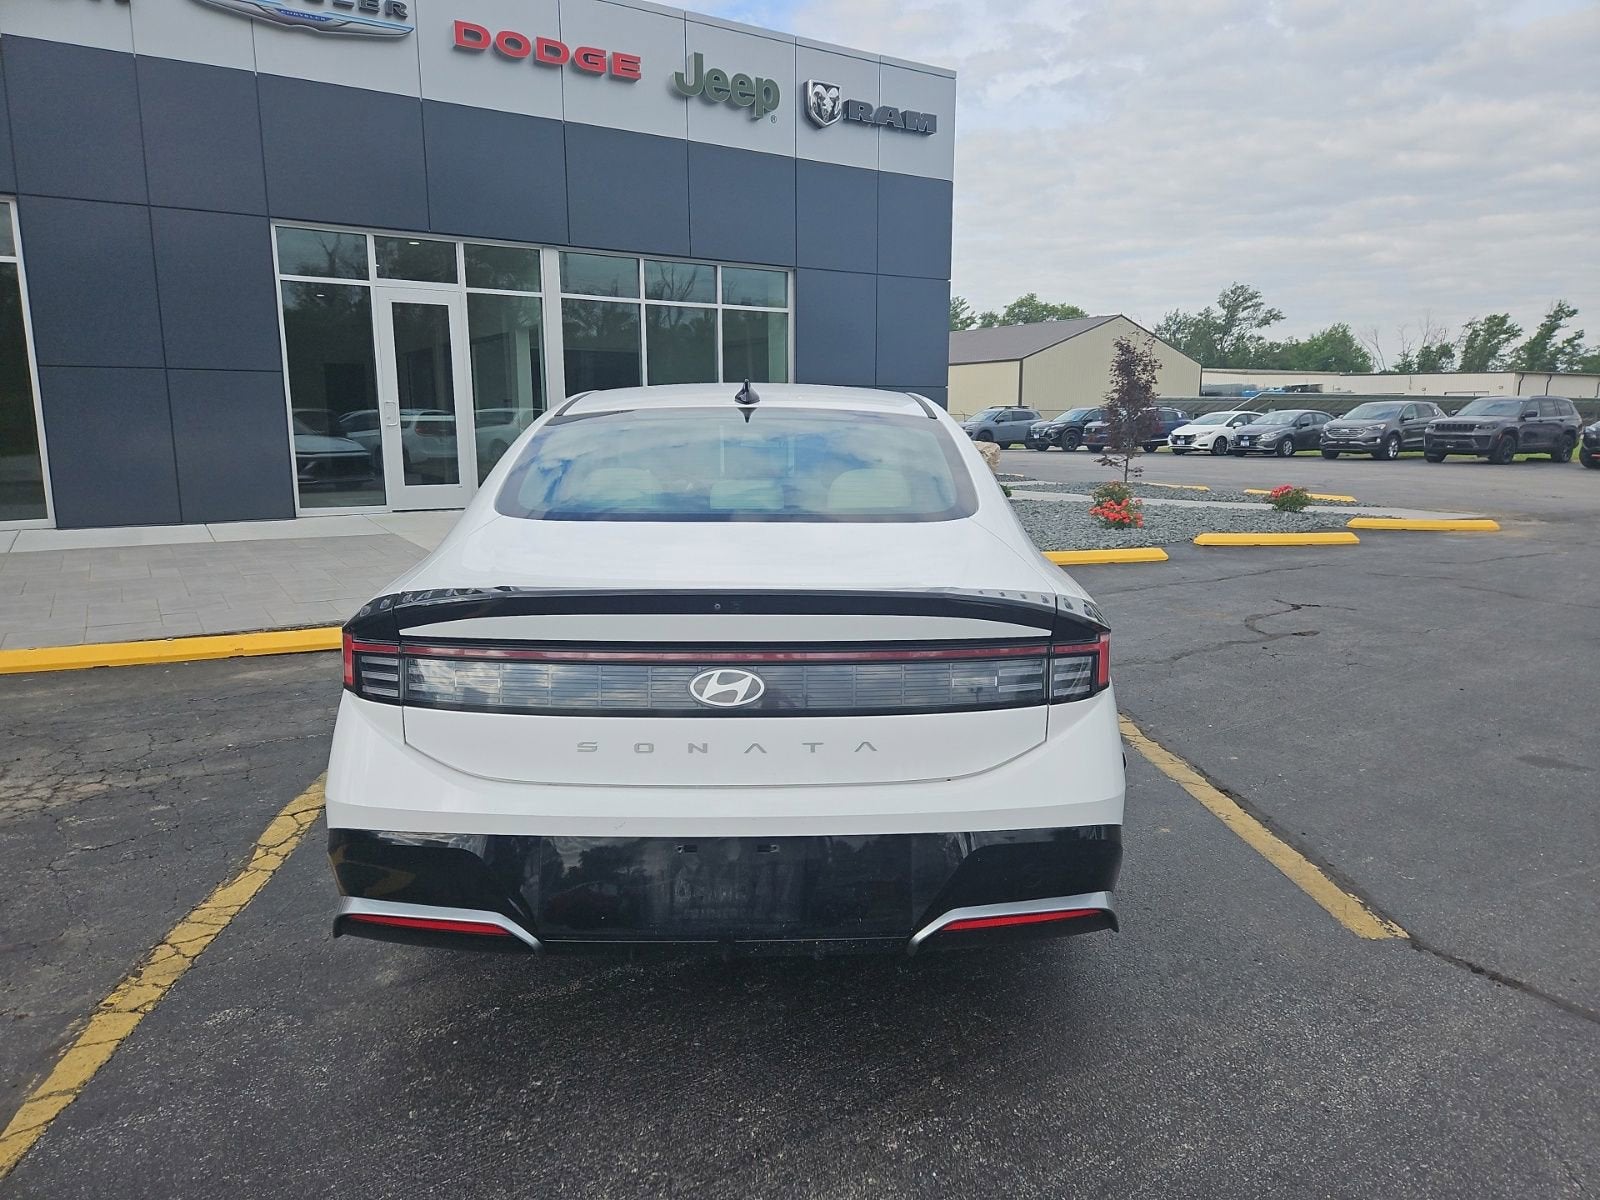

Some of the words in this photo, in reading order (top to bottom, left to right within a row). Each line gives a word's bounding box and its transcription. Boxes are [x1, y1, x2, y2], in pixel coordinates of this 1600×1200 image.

[453, 19, 643, 81] DODGE
[672, 51, 781, 119] Jeep
[842, 99, 938, 134] RAM
[576, 740, 878, 754] SONATA
